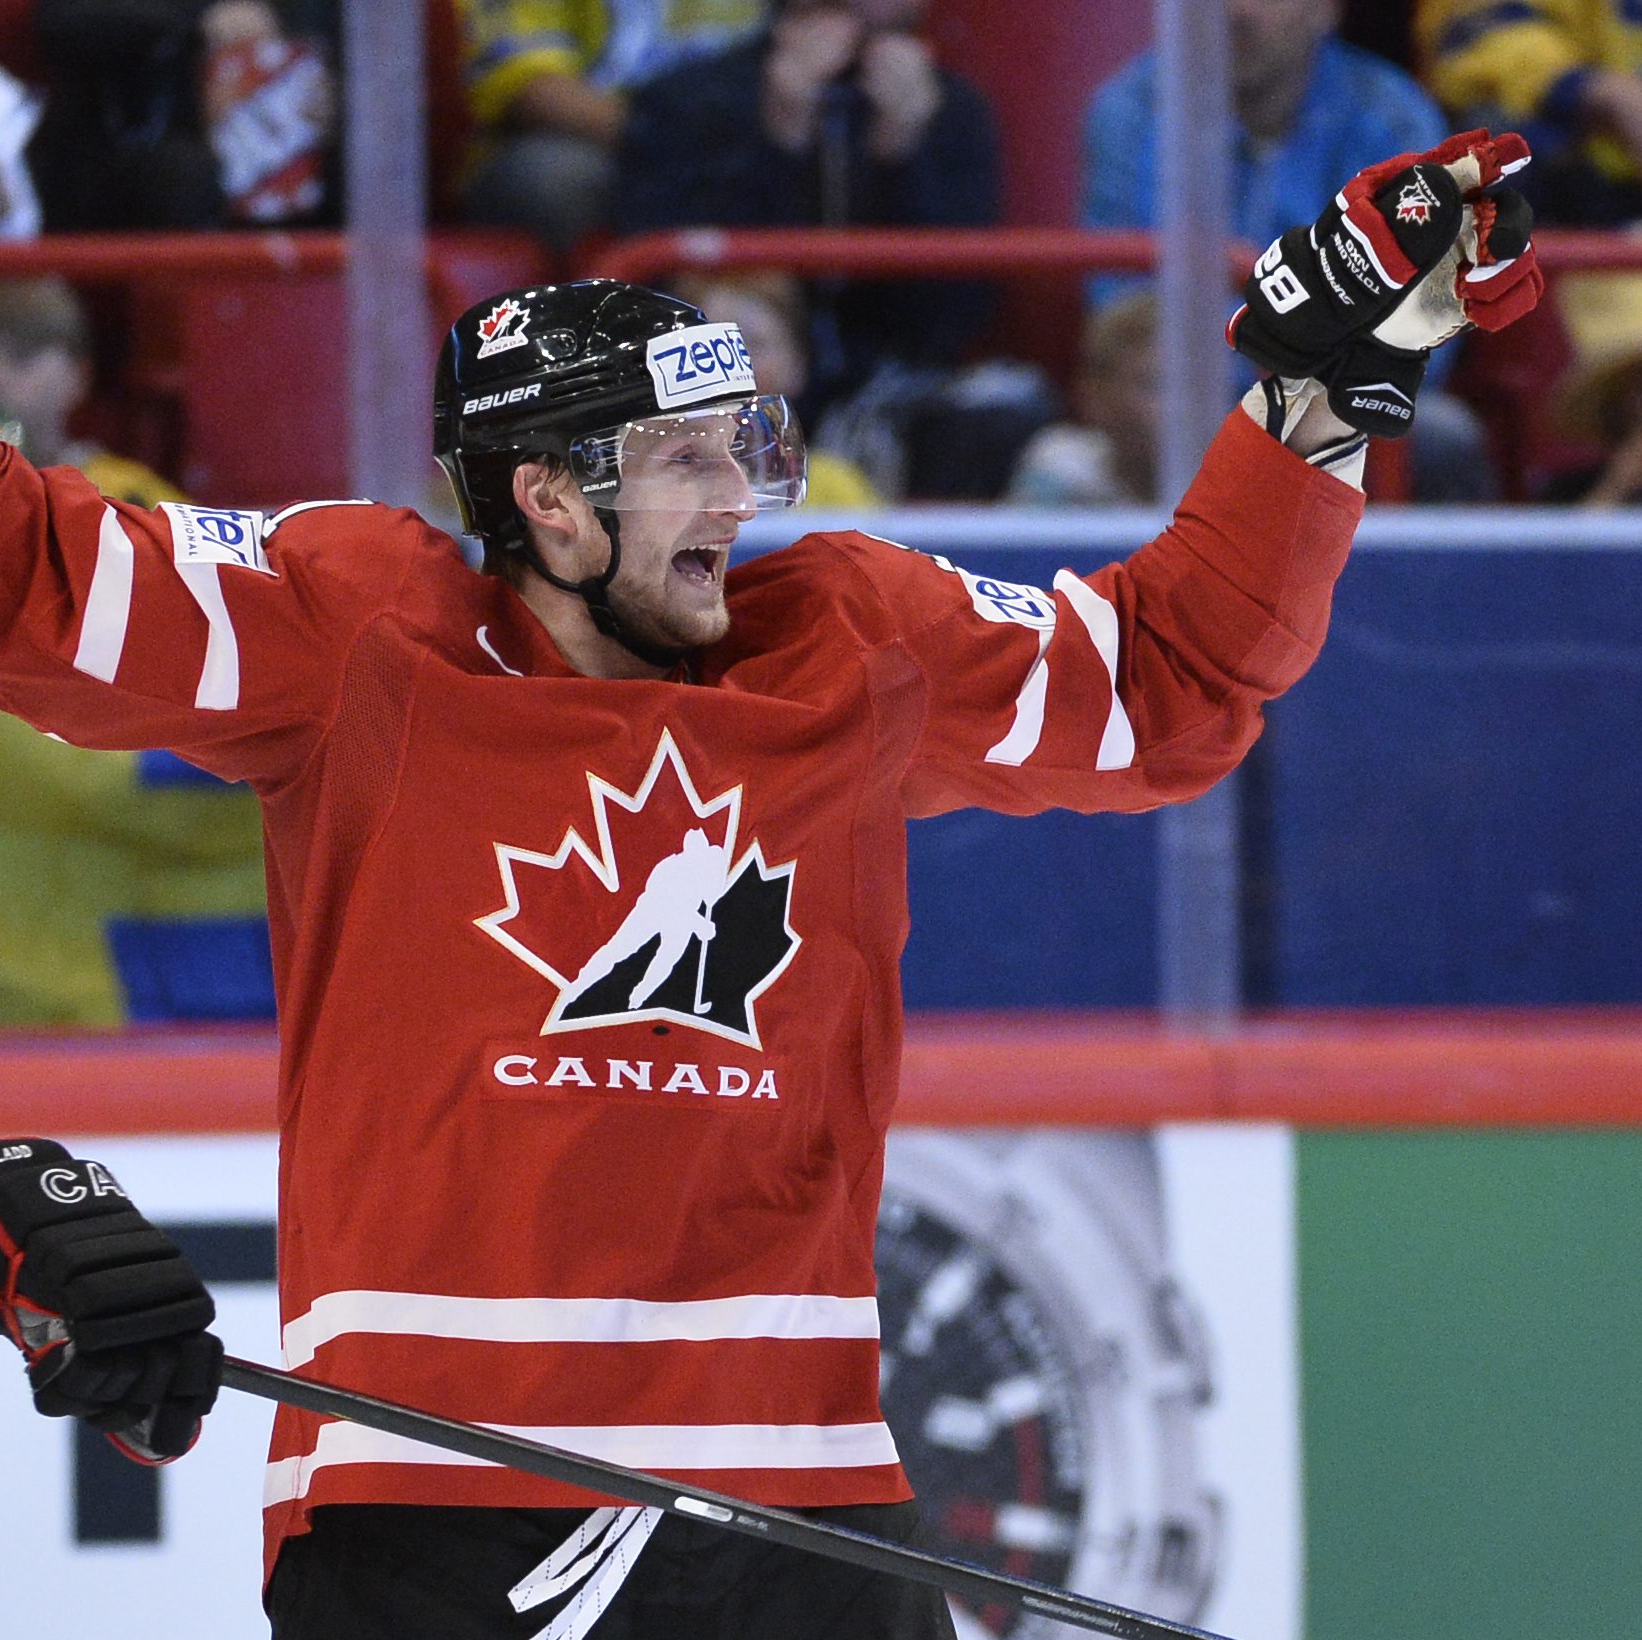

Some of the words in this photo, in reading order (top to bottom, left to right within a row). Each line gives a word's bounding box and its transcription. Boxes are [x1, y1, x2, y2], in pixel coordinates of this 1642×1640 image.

[462, 382, 542, 415] BAUER
[1351, 395, 1412, 420] BAUER
[493, 1054, 779, 1100] CANADA
